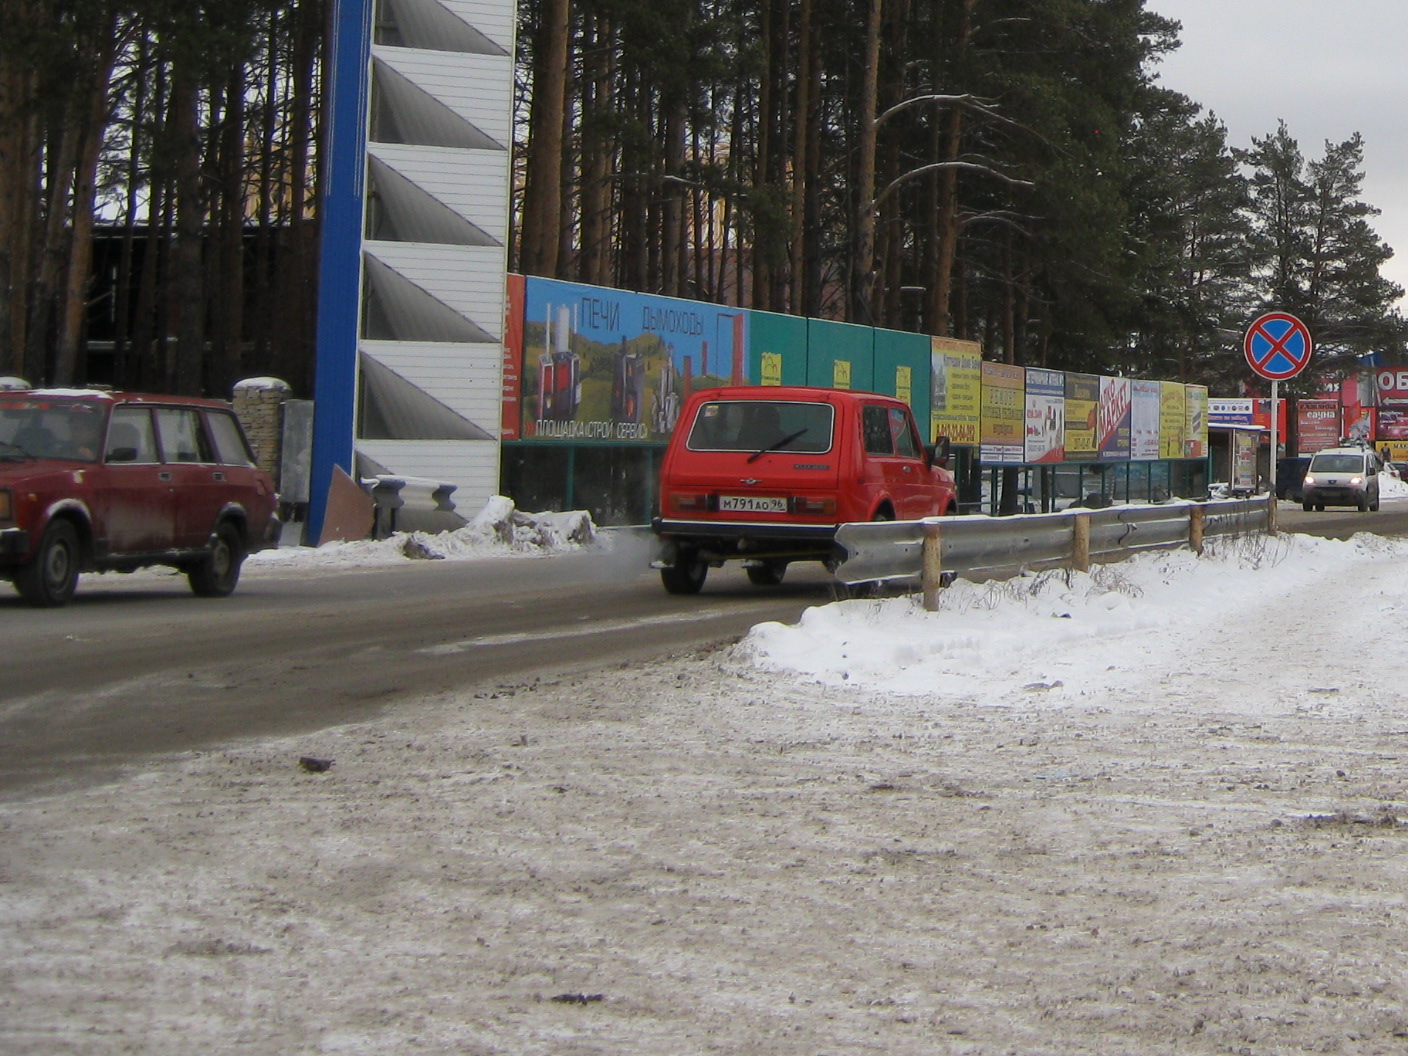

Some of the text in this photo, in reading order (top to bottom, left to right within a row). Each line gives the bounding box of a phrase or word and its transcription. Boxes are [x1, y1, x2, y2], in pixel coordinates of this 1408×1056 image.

[581, 297, 704, 336] ПЕЧИ ДЫМОХОДЫ
[535, 419, 584, 439] ПЛОЩАДКА
